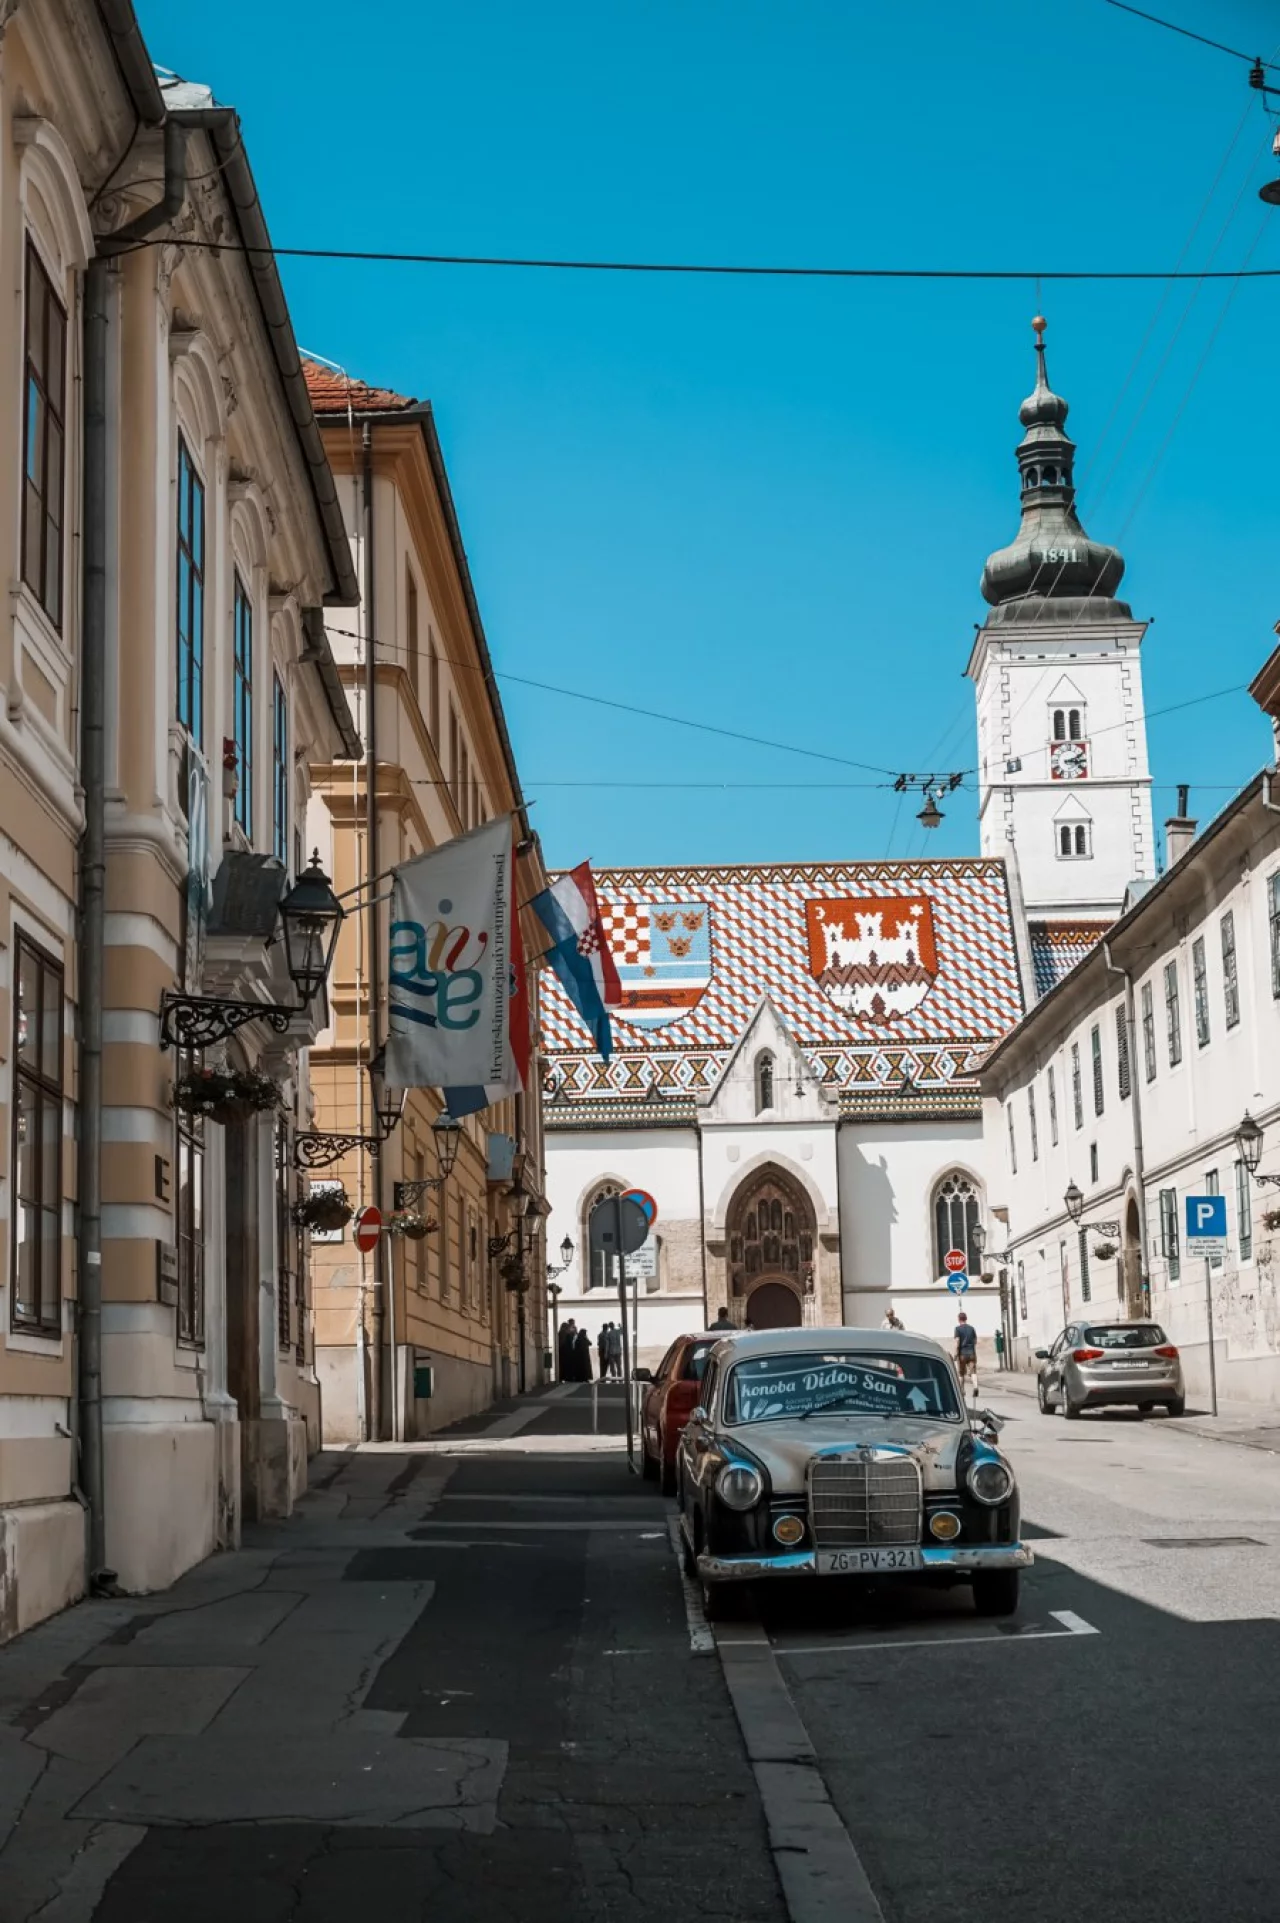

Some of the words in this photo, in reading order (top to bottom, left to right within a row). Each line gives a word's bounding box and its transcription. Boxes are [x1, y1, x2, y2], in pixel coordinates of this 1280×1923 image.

[1197, 1203, 1214, 1229] P
[946, 1256, 965, 1266] STOP
[802, 1370, 858, 1391] Didov
[862, 1374, 897, 1396] San
[830, 1554, 849, 1571] ZG
